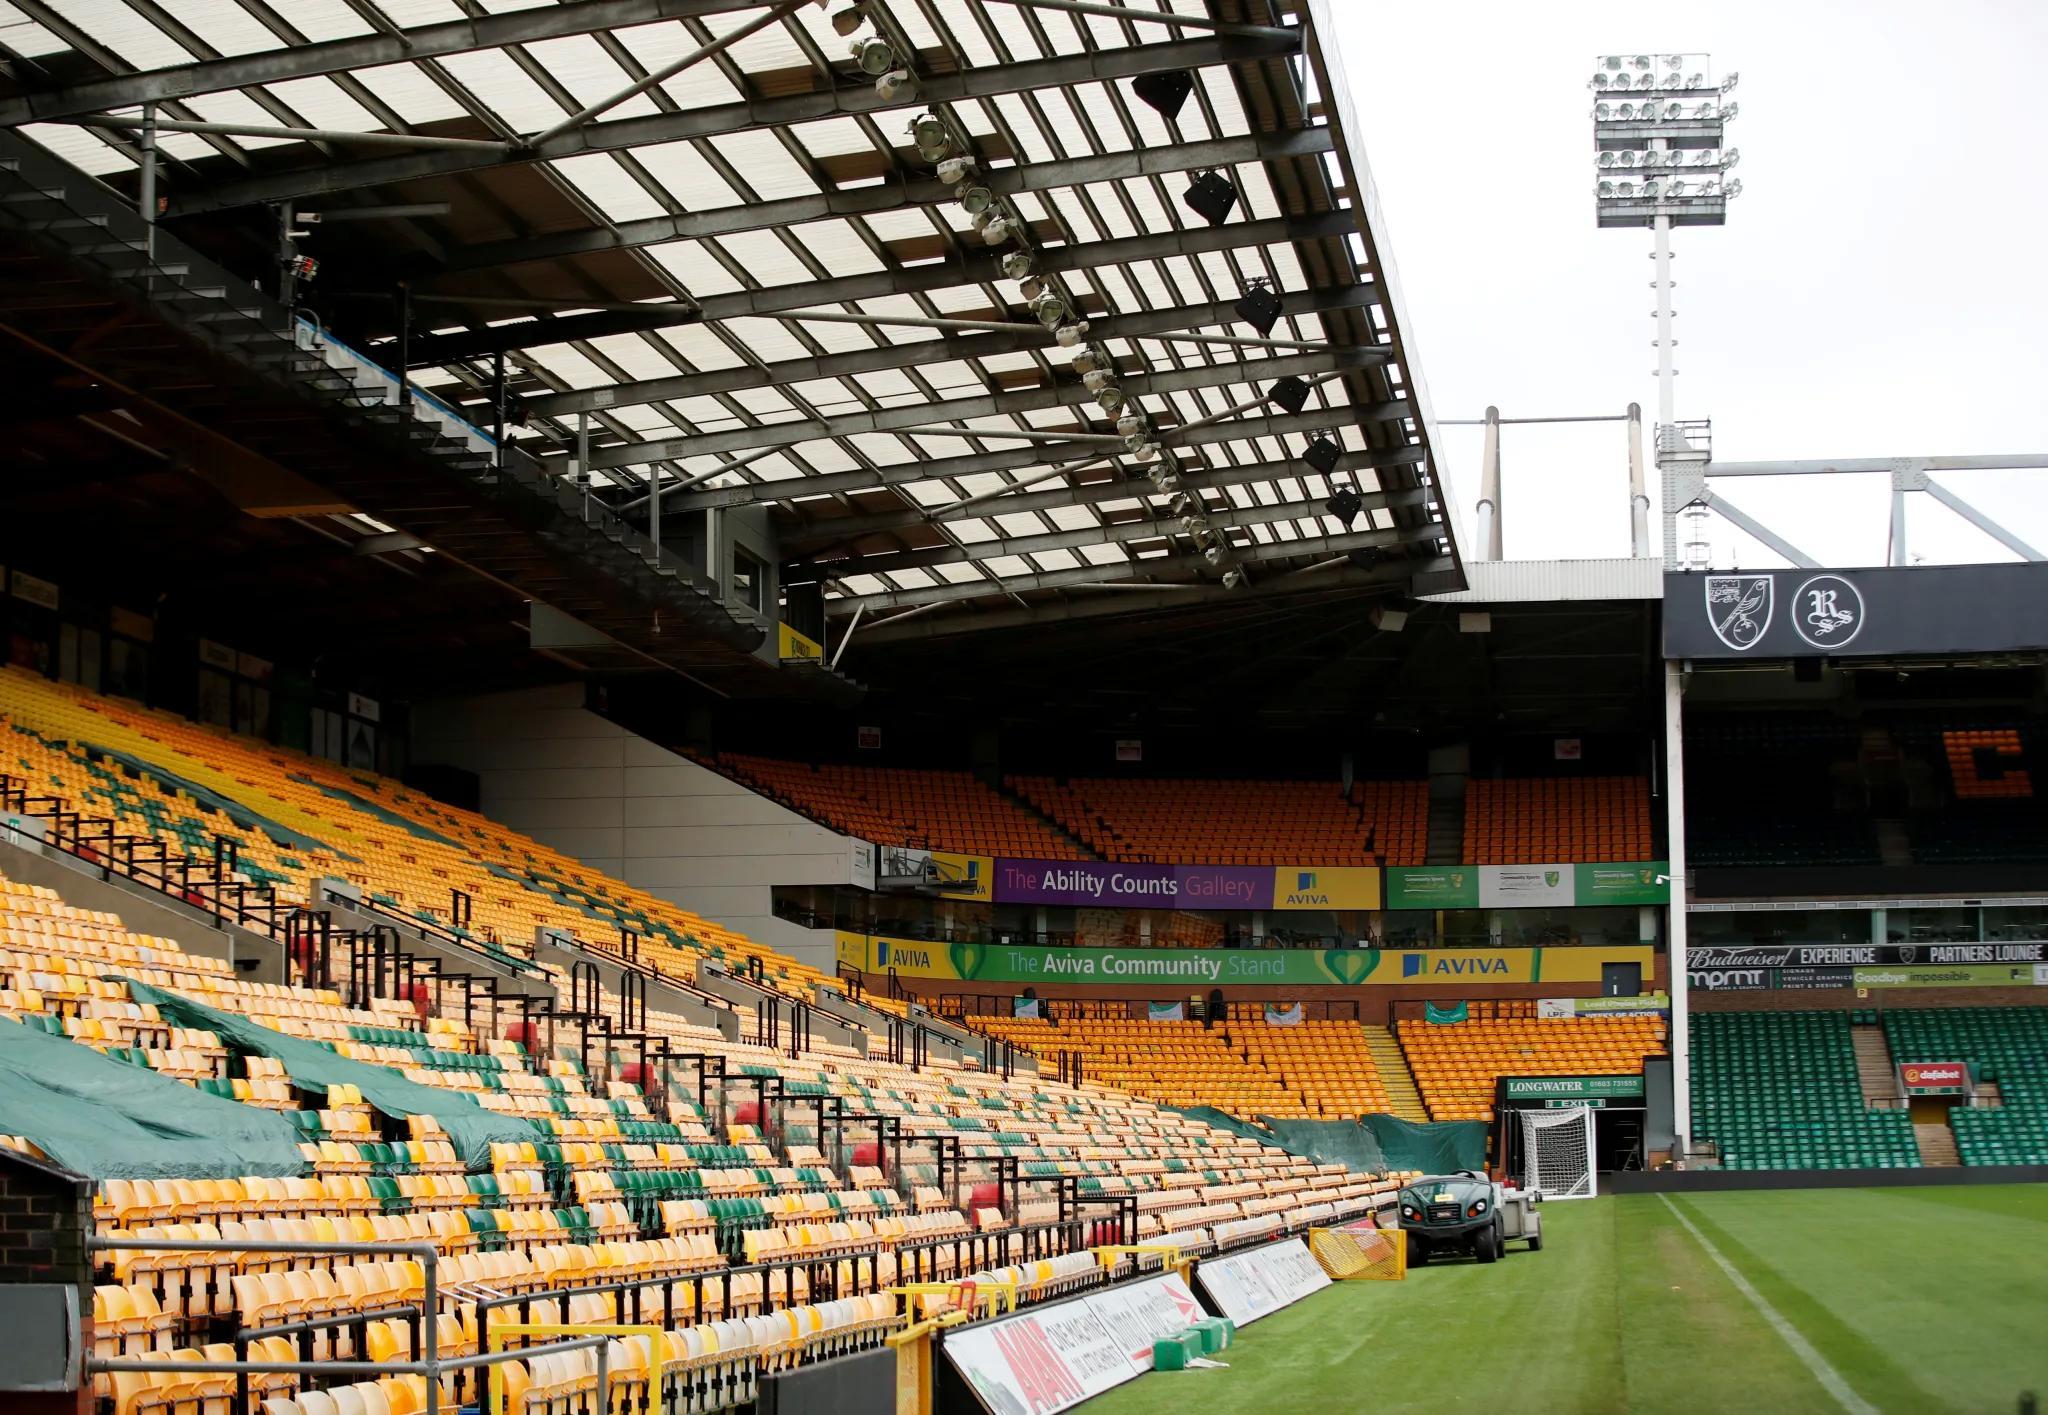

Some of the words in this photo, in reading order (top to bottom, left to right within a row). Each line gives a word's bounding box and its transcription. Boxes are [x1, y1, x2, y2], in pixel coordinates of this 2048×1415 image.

[1942, 730, 2034, 798] C
[1005, 868, 1037, 890] The
[1042, 870, 1105, 897] Ability
[1111, 872, 1178, 895] Counts
[1185, 875, 1256, 901] Gallery
[1286, 894, 1329, 905] AVIVA
[893, 949, 931, 968] AVIVA
[1687, 949, 1787, 967] Budweiser
[1800, 948, 1876, 964] EXPERIENCE
[1930, 946, 1993, 962] PARTNERS
[1995, 945, 2043, 960] LOUNGE
[1008, 952, 1038, 973] The
[1043, 953, 1095, 974] Aviva
[1101, 955, 1222, 979] Community
[1228, 956, 1285, 976] Stand
[1434, 958, 1509, 974] AVIVA
[1855, 972, 1907, 984] Goodbye
[1920, 1069, 1960, 1080] dafabet
[1509, 1081, 1583, 1092] LONGWATER
[990, 1316, 1086, 1415] AVANT
